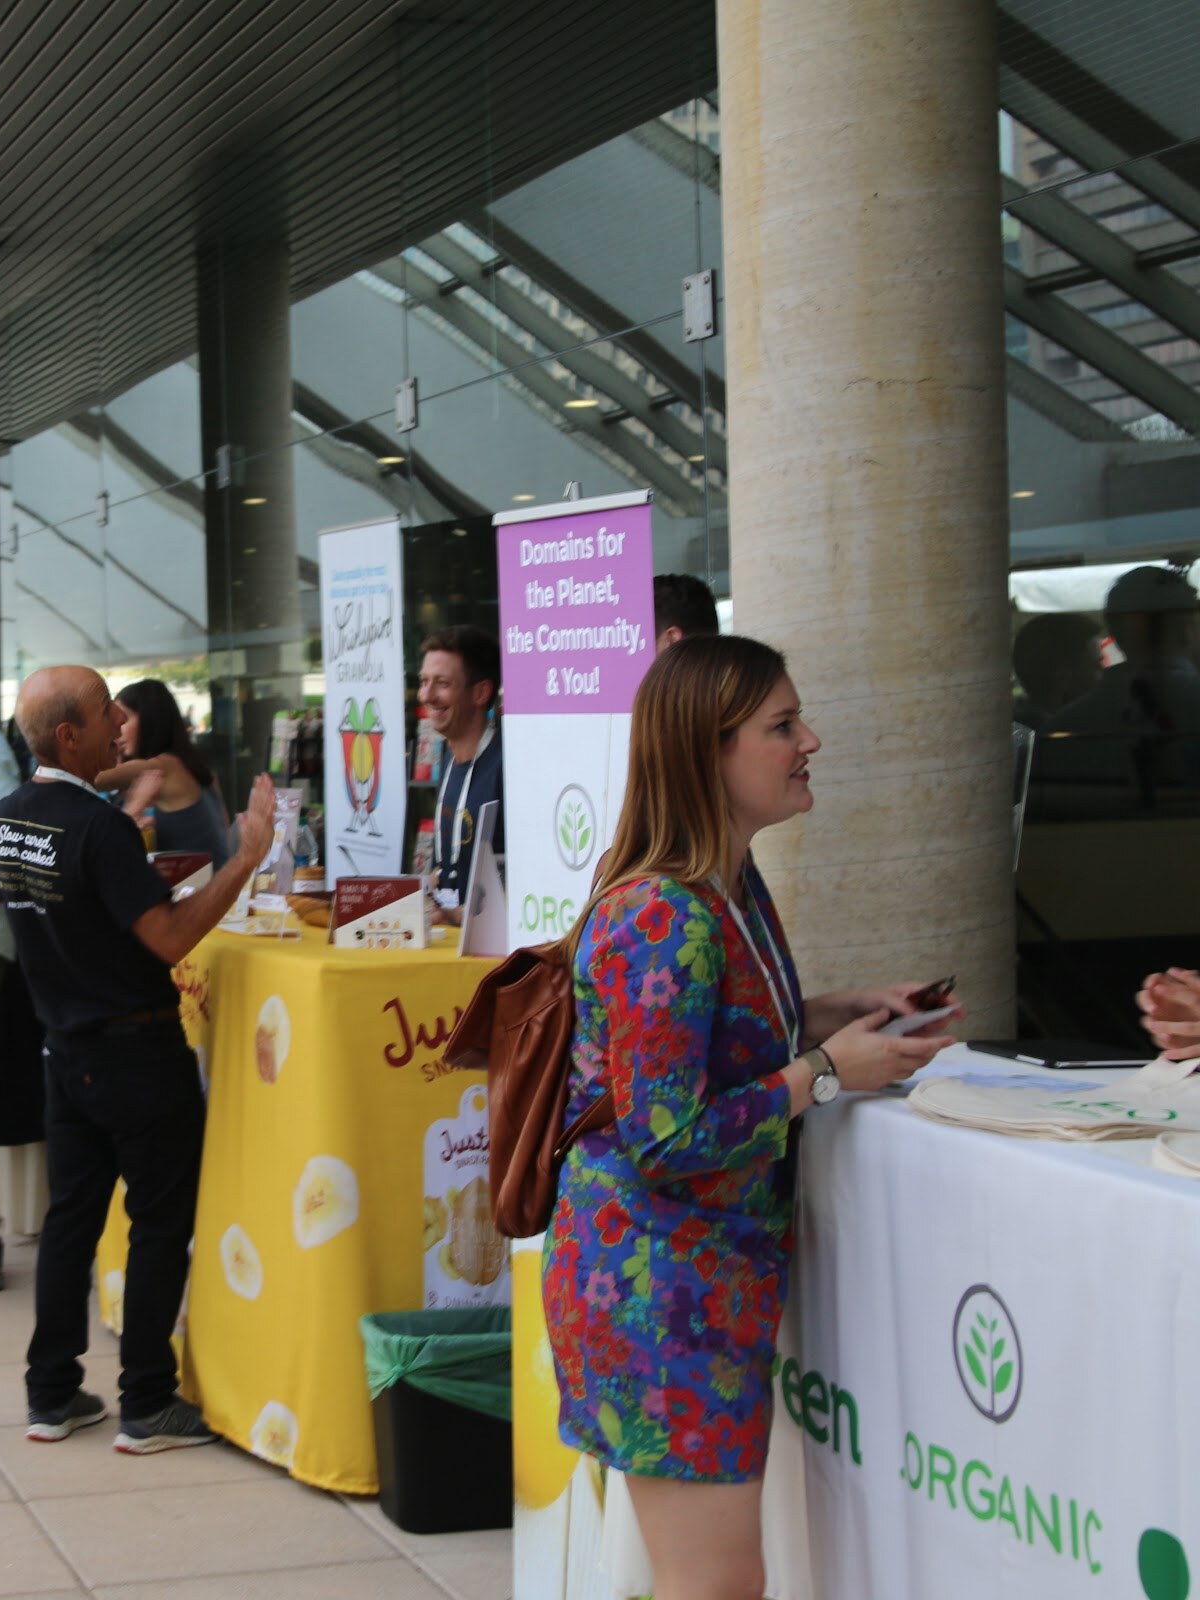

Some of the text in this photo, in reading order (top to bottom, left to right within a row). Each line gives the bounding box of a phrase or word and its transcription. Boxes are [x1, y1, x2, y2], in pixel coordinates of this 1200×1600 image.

[520, 527, 626, 567] Domains for
[525, 574, 620, 610] the Planet,
[506, 617, 647, 656] the Community,
[546, 666, 601, 696] & You!
[20, 849, 57, 868] cooked
[899, 1430, 1102, 1575] .ORGANIC
